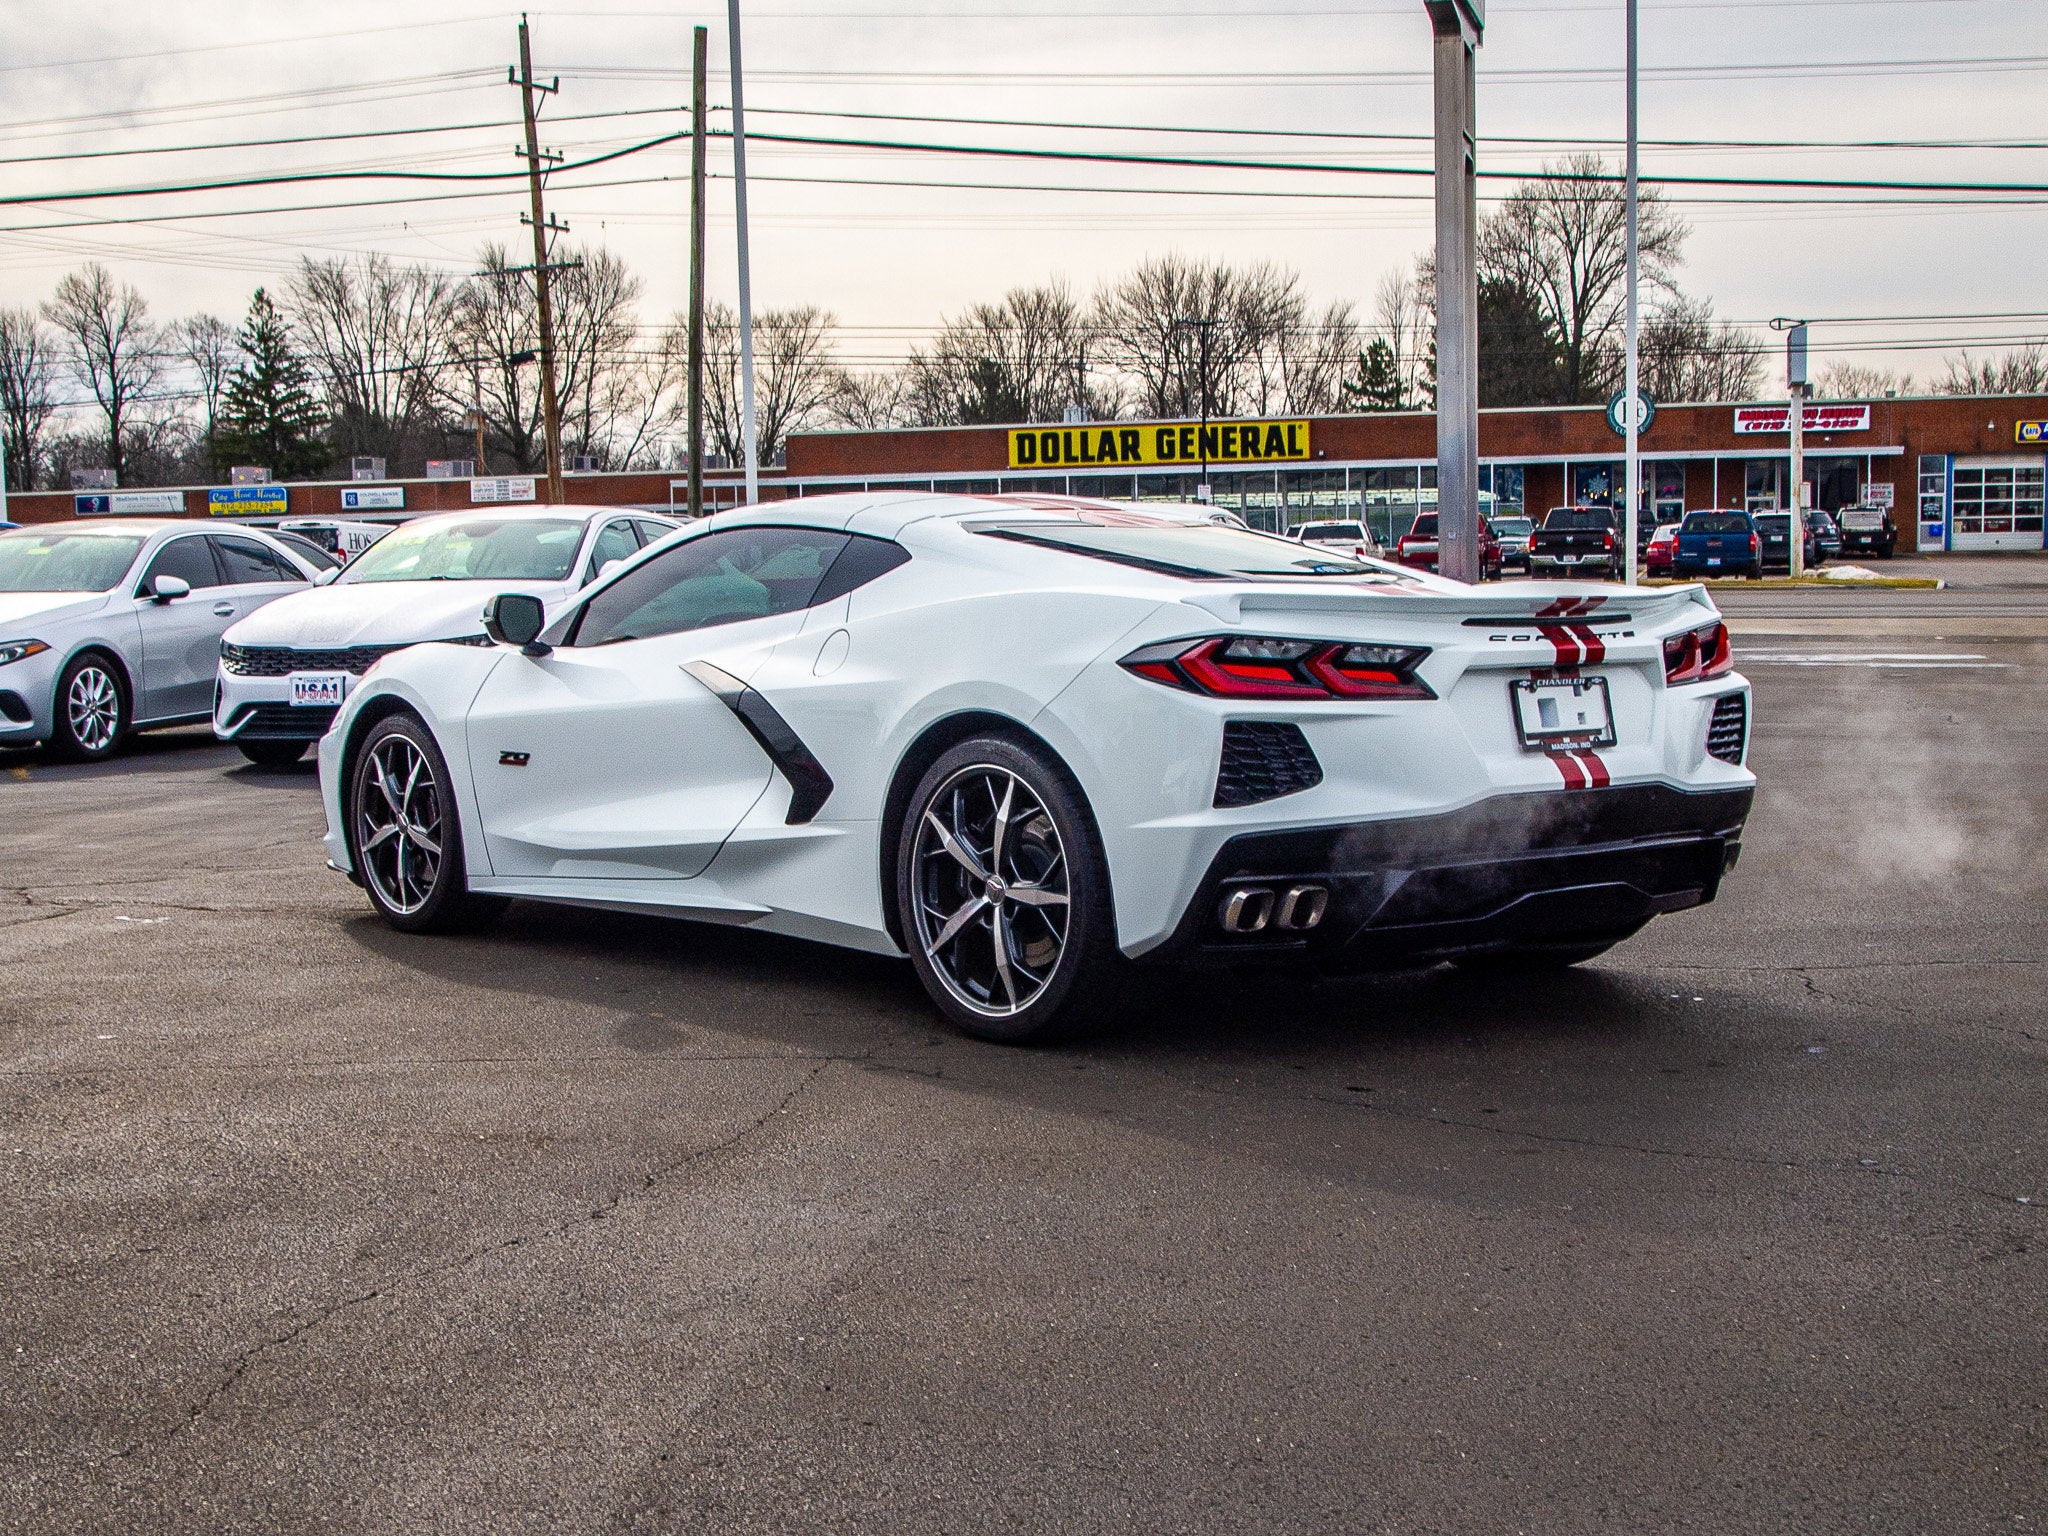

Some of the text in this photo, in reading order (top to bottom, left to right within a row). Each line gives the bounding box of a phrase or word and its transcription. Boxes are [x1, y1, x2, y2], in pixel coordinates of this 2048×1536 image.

[1738, 410, 1788, 421] MADISON
[1819, 407, 1866, 419] SERVICE
[1016, 424, 1304, 464] DOLLAR GENERAL
[1489, 630, 1635, 642] CORVETTE
